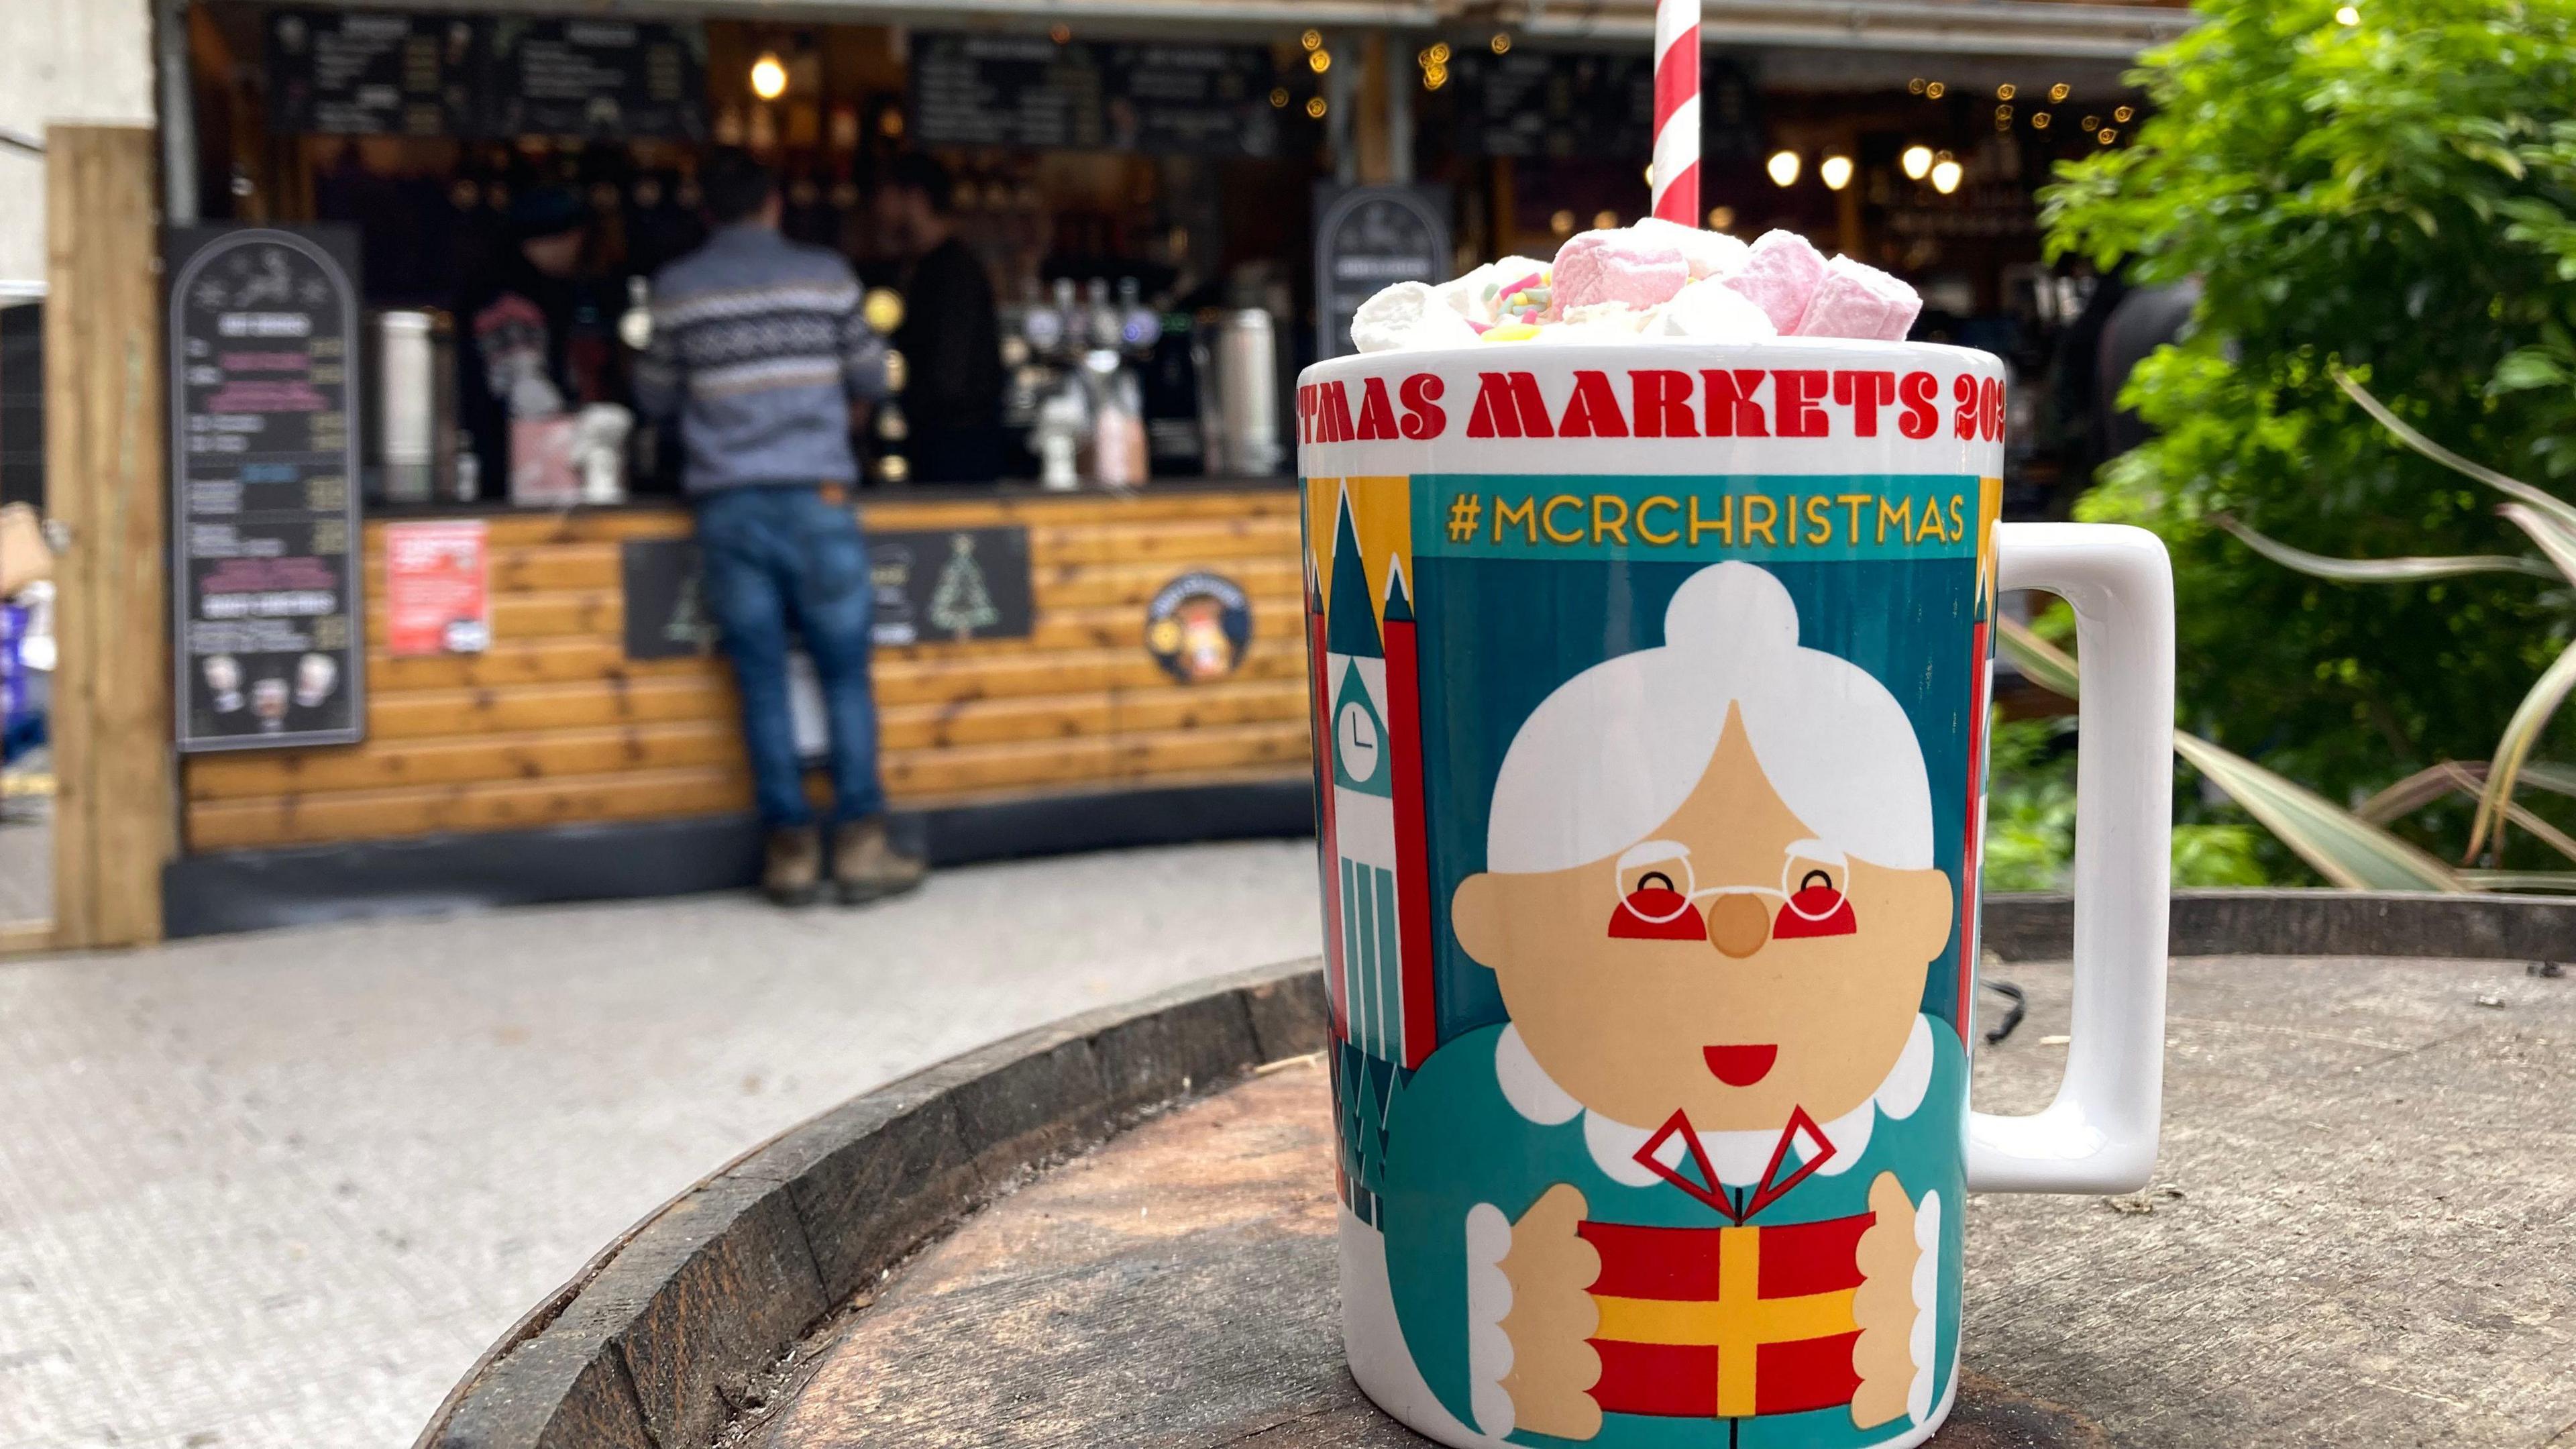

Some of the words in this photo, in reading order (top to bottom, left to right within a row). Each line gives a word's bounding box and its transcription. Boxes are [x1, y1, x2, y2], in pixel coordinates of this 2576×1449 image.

[1296, 373, 1447, 445] TMAS
[1466, 369, 1939, 439] MARKETS
[1446, 493, 1964, 547] #MCRCHRISTMAS
